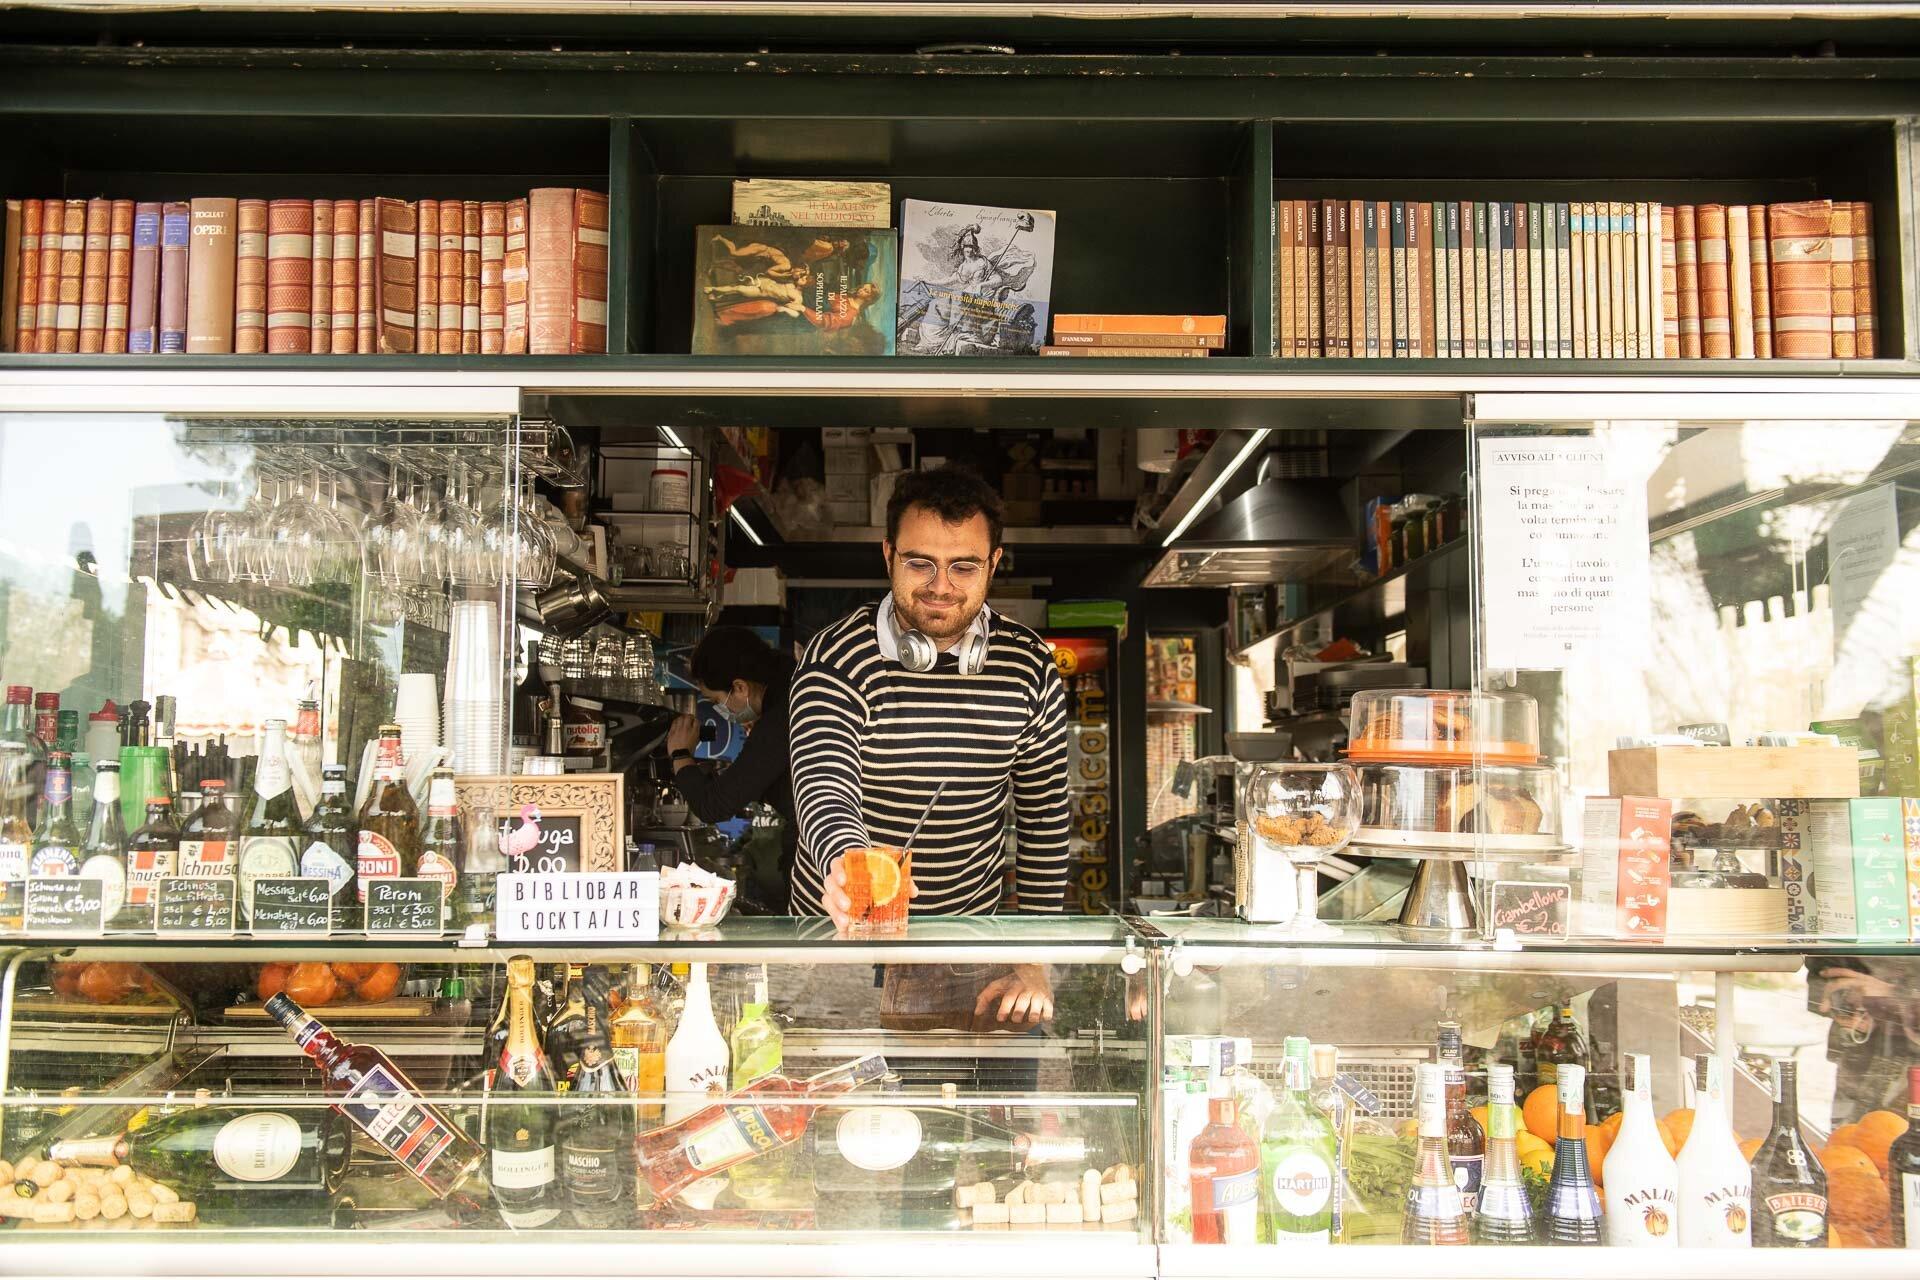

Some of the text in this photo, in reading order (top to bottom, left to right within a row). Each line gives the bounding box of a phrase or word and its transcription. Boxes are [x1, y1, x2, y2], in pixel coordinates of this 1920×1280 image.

[822, 201, 877, 211] PALATINO
[790, 211, 876, 221] NEL MEDIOEVO
[827, 292, 836, 301] DI
[840, 285, 848, 319] PALAZZO
[1495, 452, 1536, 463] AVVISO
[1509, 485, 1520, 496] Si
[1517, 500, 1525, 510] la
[1520, 514, 1548, 525] volta
[1570, 587, 1582, 598] di
[1550, 604, 1595, 616] persone
[567, 724, 600, 736] nutella
[256, 882, 296, 897] Messina
[373, 884, 422, 901] Peroni
[515, 880, 639, 901] BIBLIOBAR
[1494, 889, 1565, 927] Ciambellone
[254, 908, 299, 921] Menabrea
[521, 909, 640, 930] COCKTAILS
[568, 1154, 600, 1168] MASCHIO
[1277, 1176, 1328, 1191] MARTINI
[1771, 1192, 1828, 1211] BAILEYS
